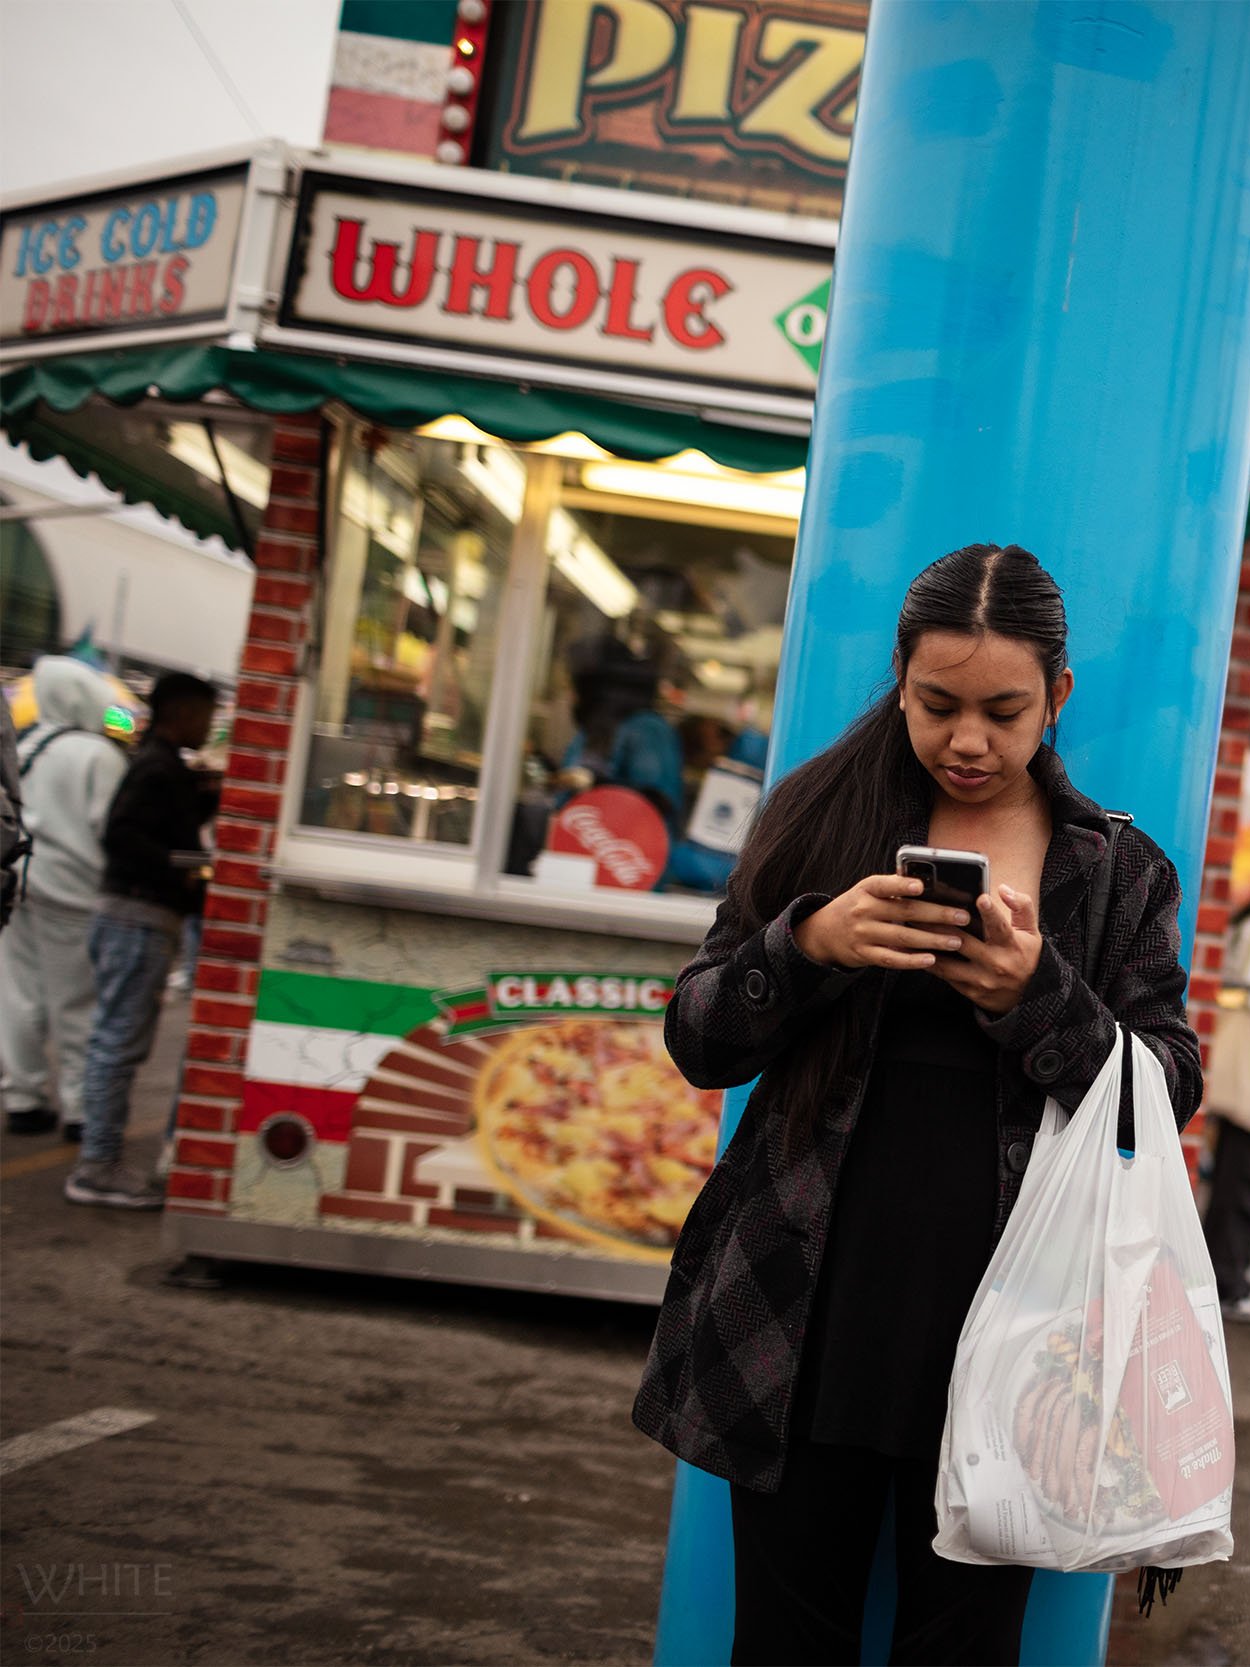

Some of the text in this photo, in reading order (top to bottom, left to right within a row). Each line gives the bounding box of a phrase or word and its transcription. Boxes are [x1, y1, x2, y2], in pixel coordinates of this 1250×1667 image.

[14, 192, 218, 278] ICE COLD
[22, 254, 190, 336] DRINKS
[330, 215, 734, 350] WHOLE
[497, 976, 667, 1010] CLASSIC
[1180, 1465, 1192, 1480] it
[1191, 1447, 1222, 1470] Make
